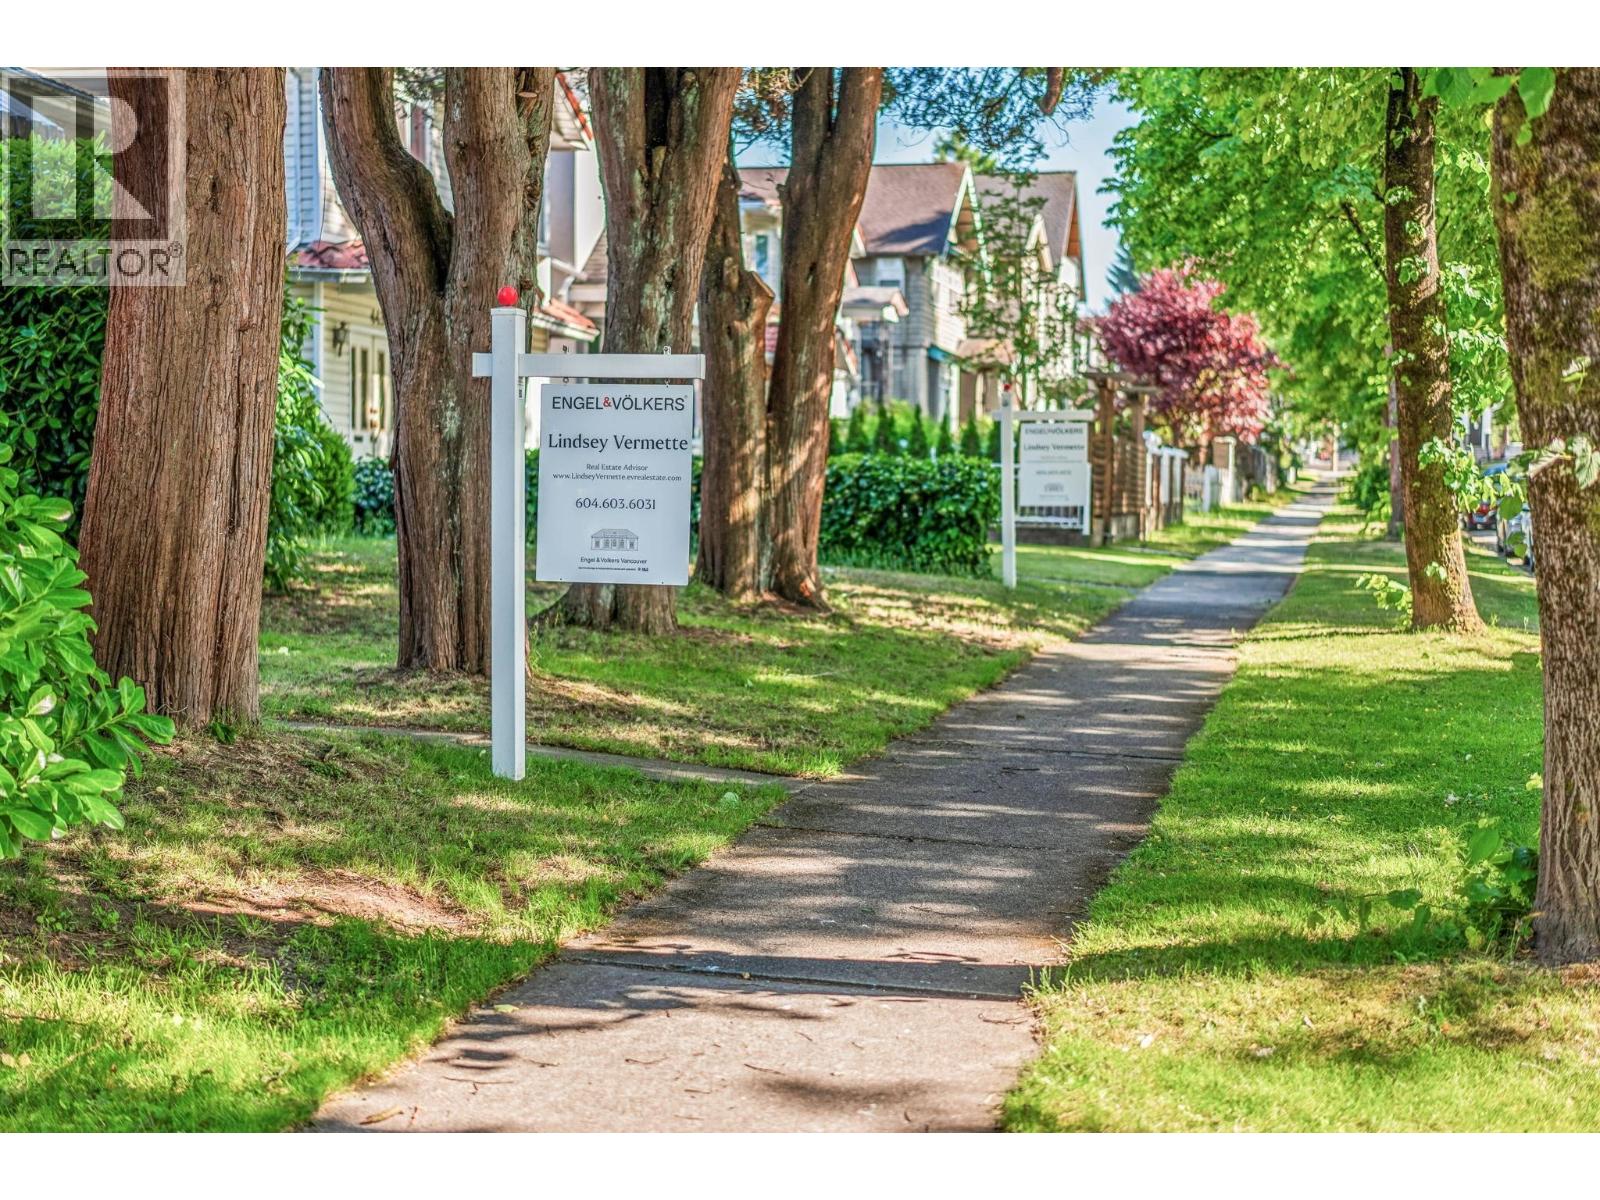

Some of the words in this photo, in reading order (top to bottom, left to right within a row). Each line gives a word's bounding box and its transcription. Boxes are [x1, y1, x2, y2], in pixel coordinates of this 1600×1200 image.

[552, 394, 685, 411] ENGEL&VÖLKERS
[548, 433, 609, 453] Lindsey
[613, 434, 689, 451] Vermette
[575, 497, 656, 510] 604.603.6031
[580, 556, 595, 564] Engel
